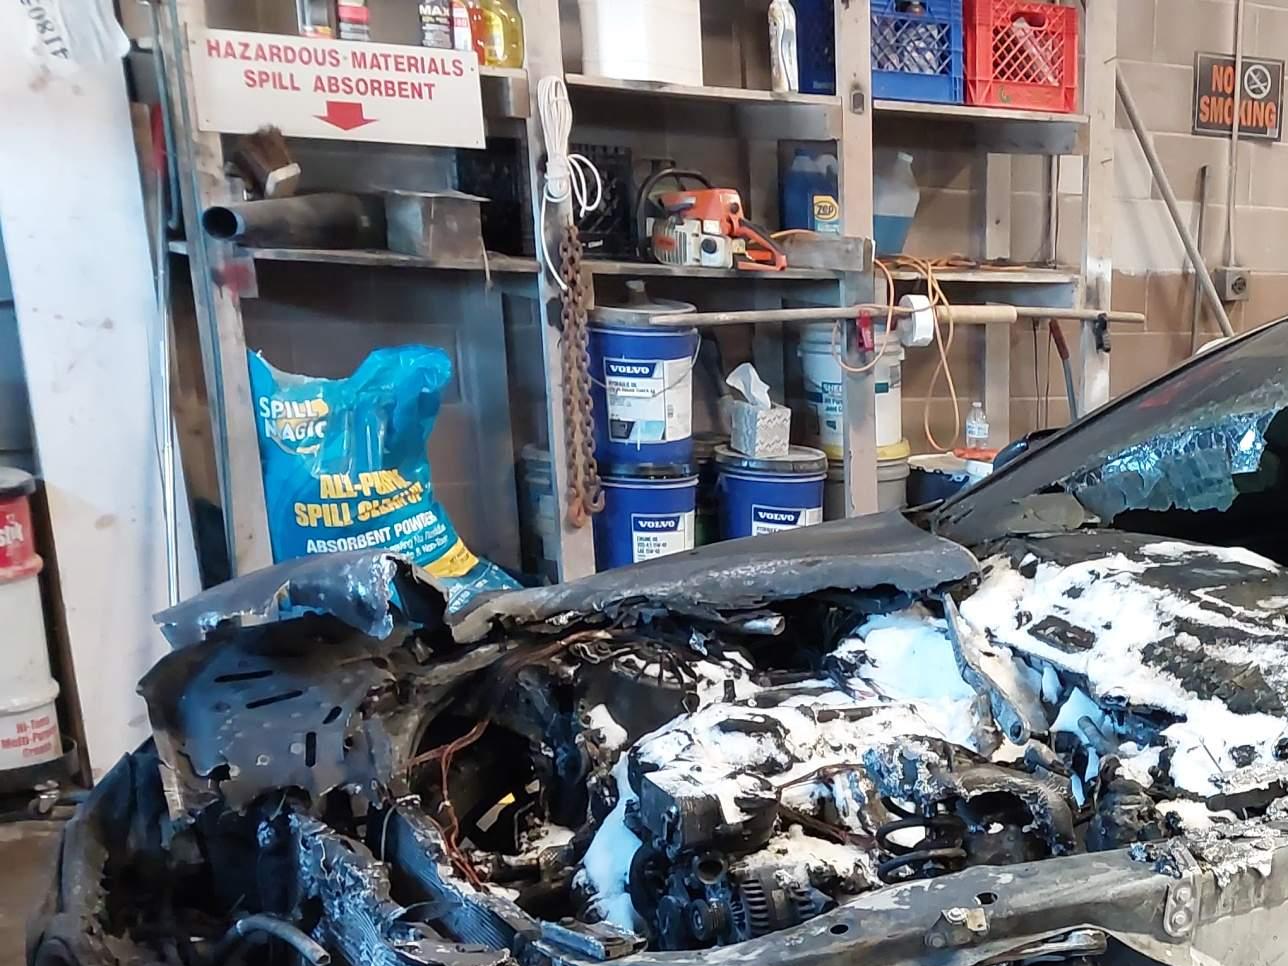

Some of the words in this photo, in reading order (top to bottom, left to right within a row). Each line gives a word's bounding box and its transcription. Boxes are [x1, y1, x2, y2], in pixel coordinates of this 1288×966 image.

[207, 39, 341, 67] HAZARDOUS
[351, 51, 464, 77] MATERIALS
[244, 69, 301, 92] SPILL
[313, 75, 436, 101] ABSORBENT
[1211, 64, 1235, 95] NO
[609, 365, 650, 375] VOLVO
[259, 396, 318, 419] SPILL
[294, 502, 354, 527] SPILL
[637, 520, 676, 529] VOLVO
[758, 511, 795, 522] VOLVO
[306, 527, 391, 554] ABSORBENT
